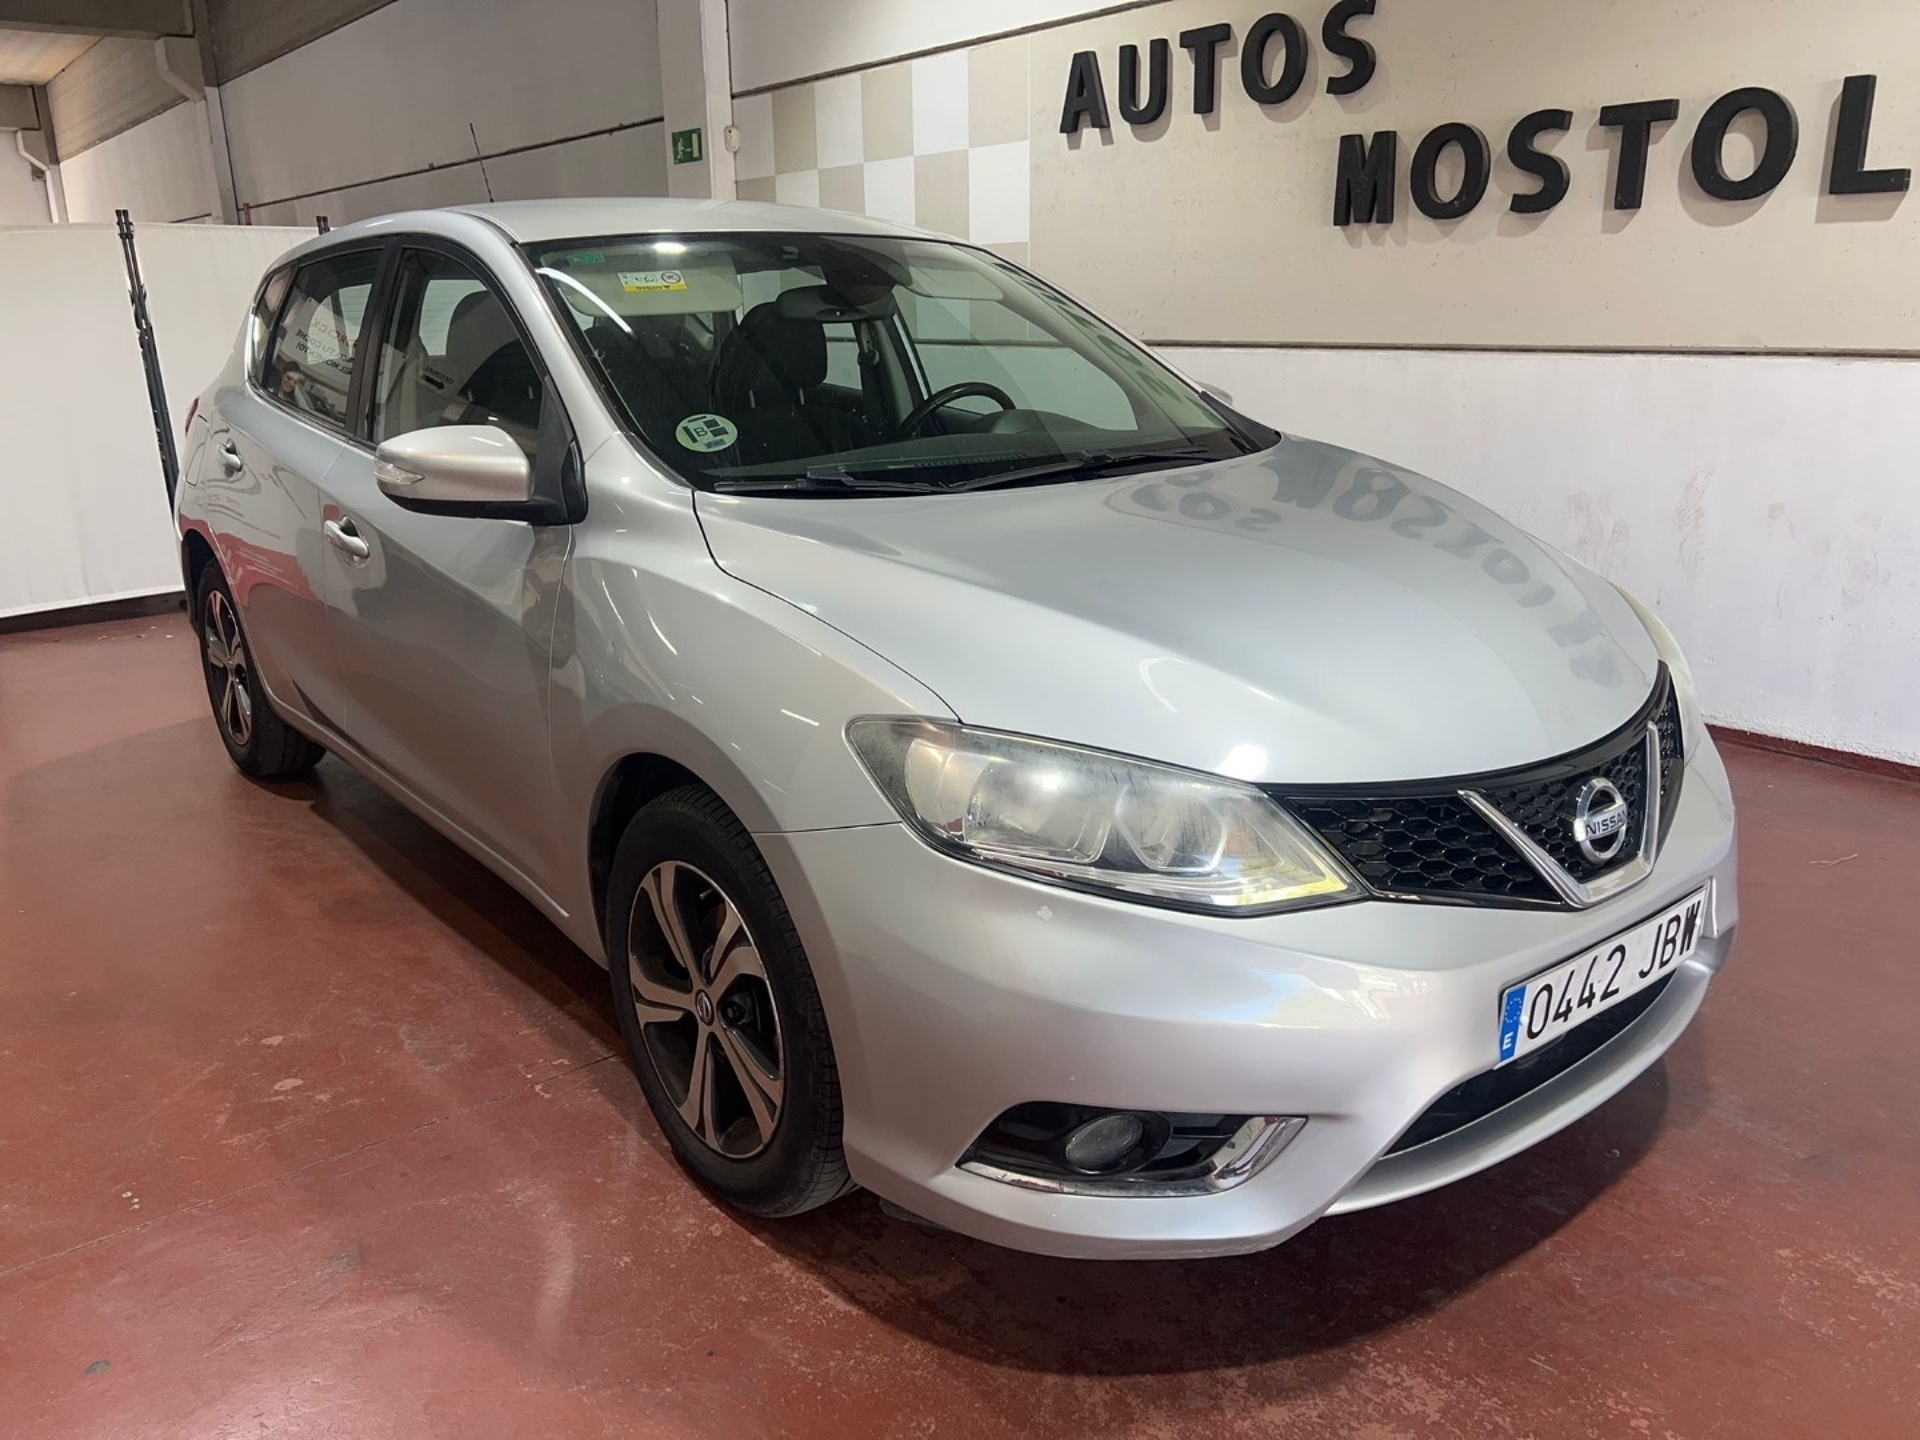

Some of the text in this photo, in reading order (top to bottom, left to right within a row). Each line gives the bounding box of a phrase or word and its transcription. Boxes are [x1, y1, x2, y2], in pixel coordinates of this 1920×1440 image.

[1060, 0, 1377, 133] AUTOS
[1333, 74, 1911, 226] MOSTOL
[694, 427, 708, 437] B
[1586, 810, 1627, 836] NISSAN
[1502, 899, 1702, 1049] E 0442 JBW
